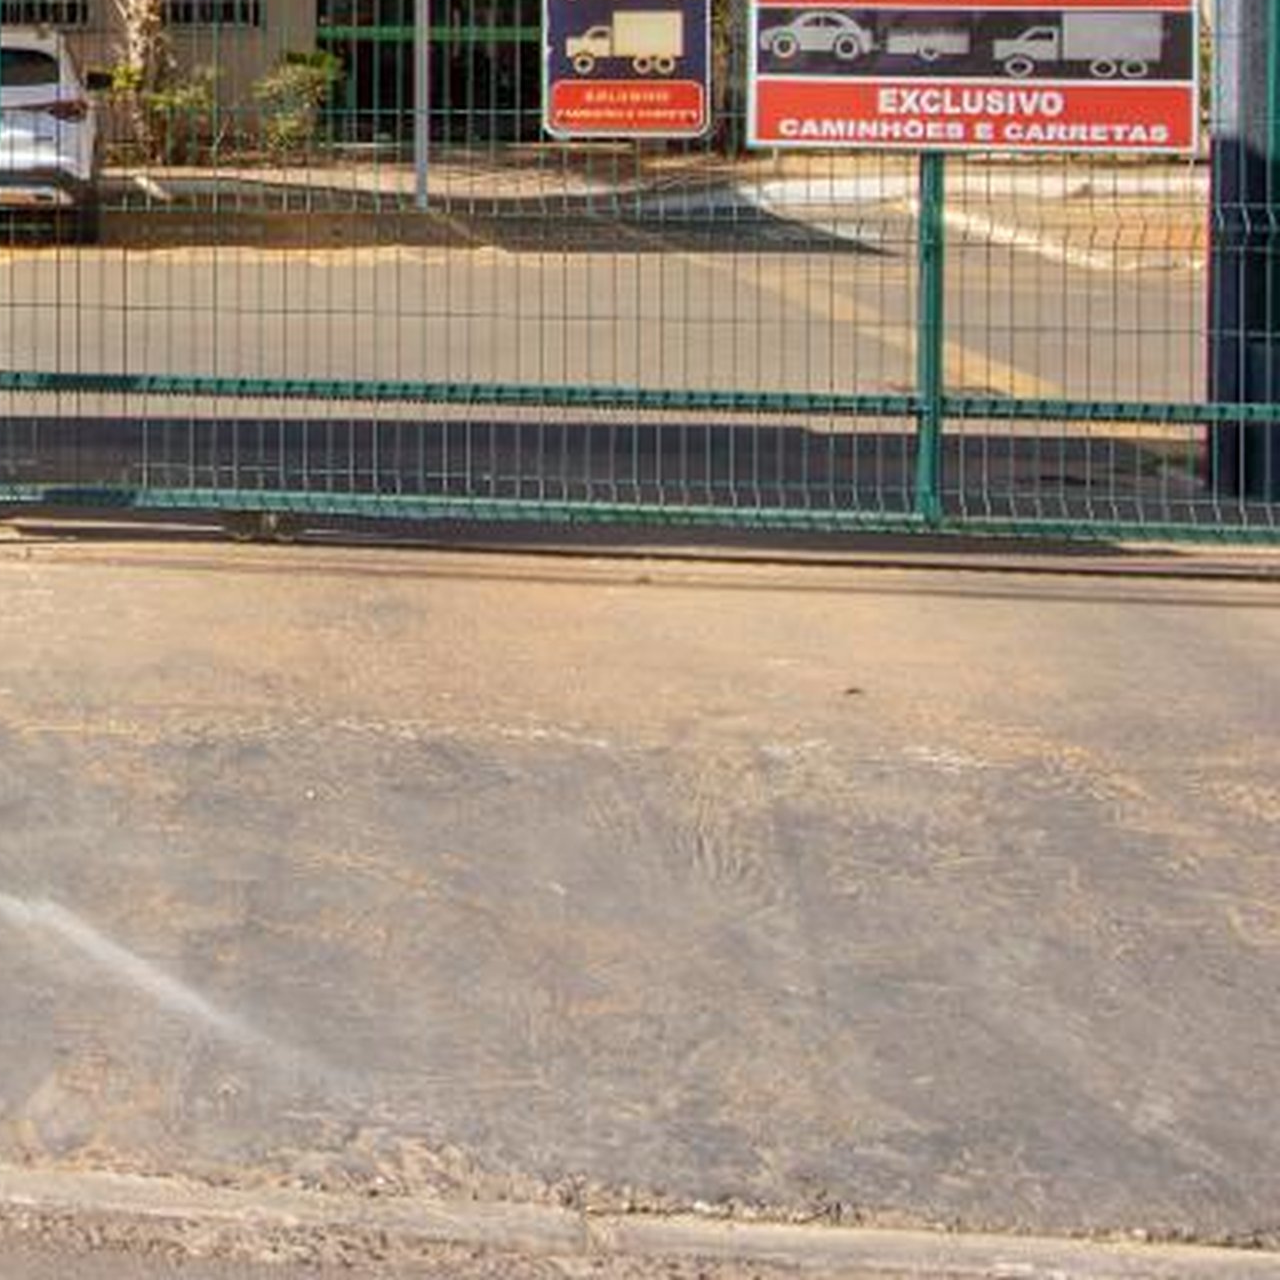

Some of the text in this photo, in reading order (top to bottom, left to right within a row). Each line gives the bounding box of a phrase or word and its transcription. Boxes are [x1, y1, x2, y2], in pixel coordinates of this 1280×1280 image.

[877, 87, 1065, 115] EXCLUSIVO
[779, 117, 1170, 143] CAMINHÕES E CARRETAS
